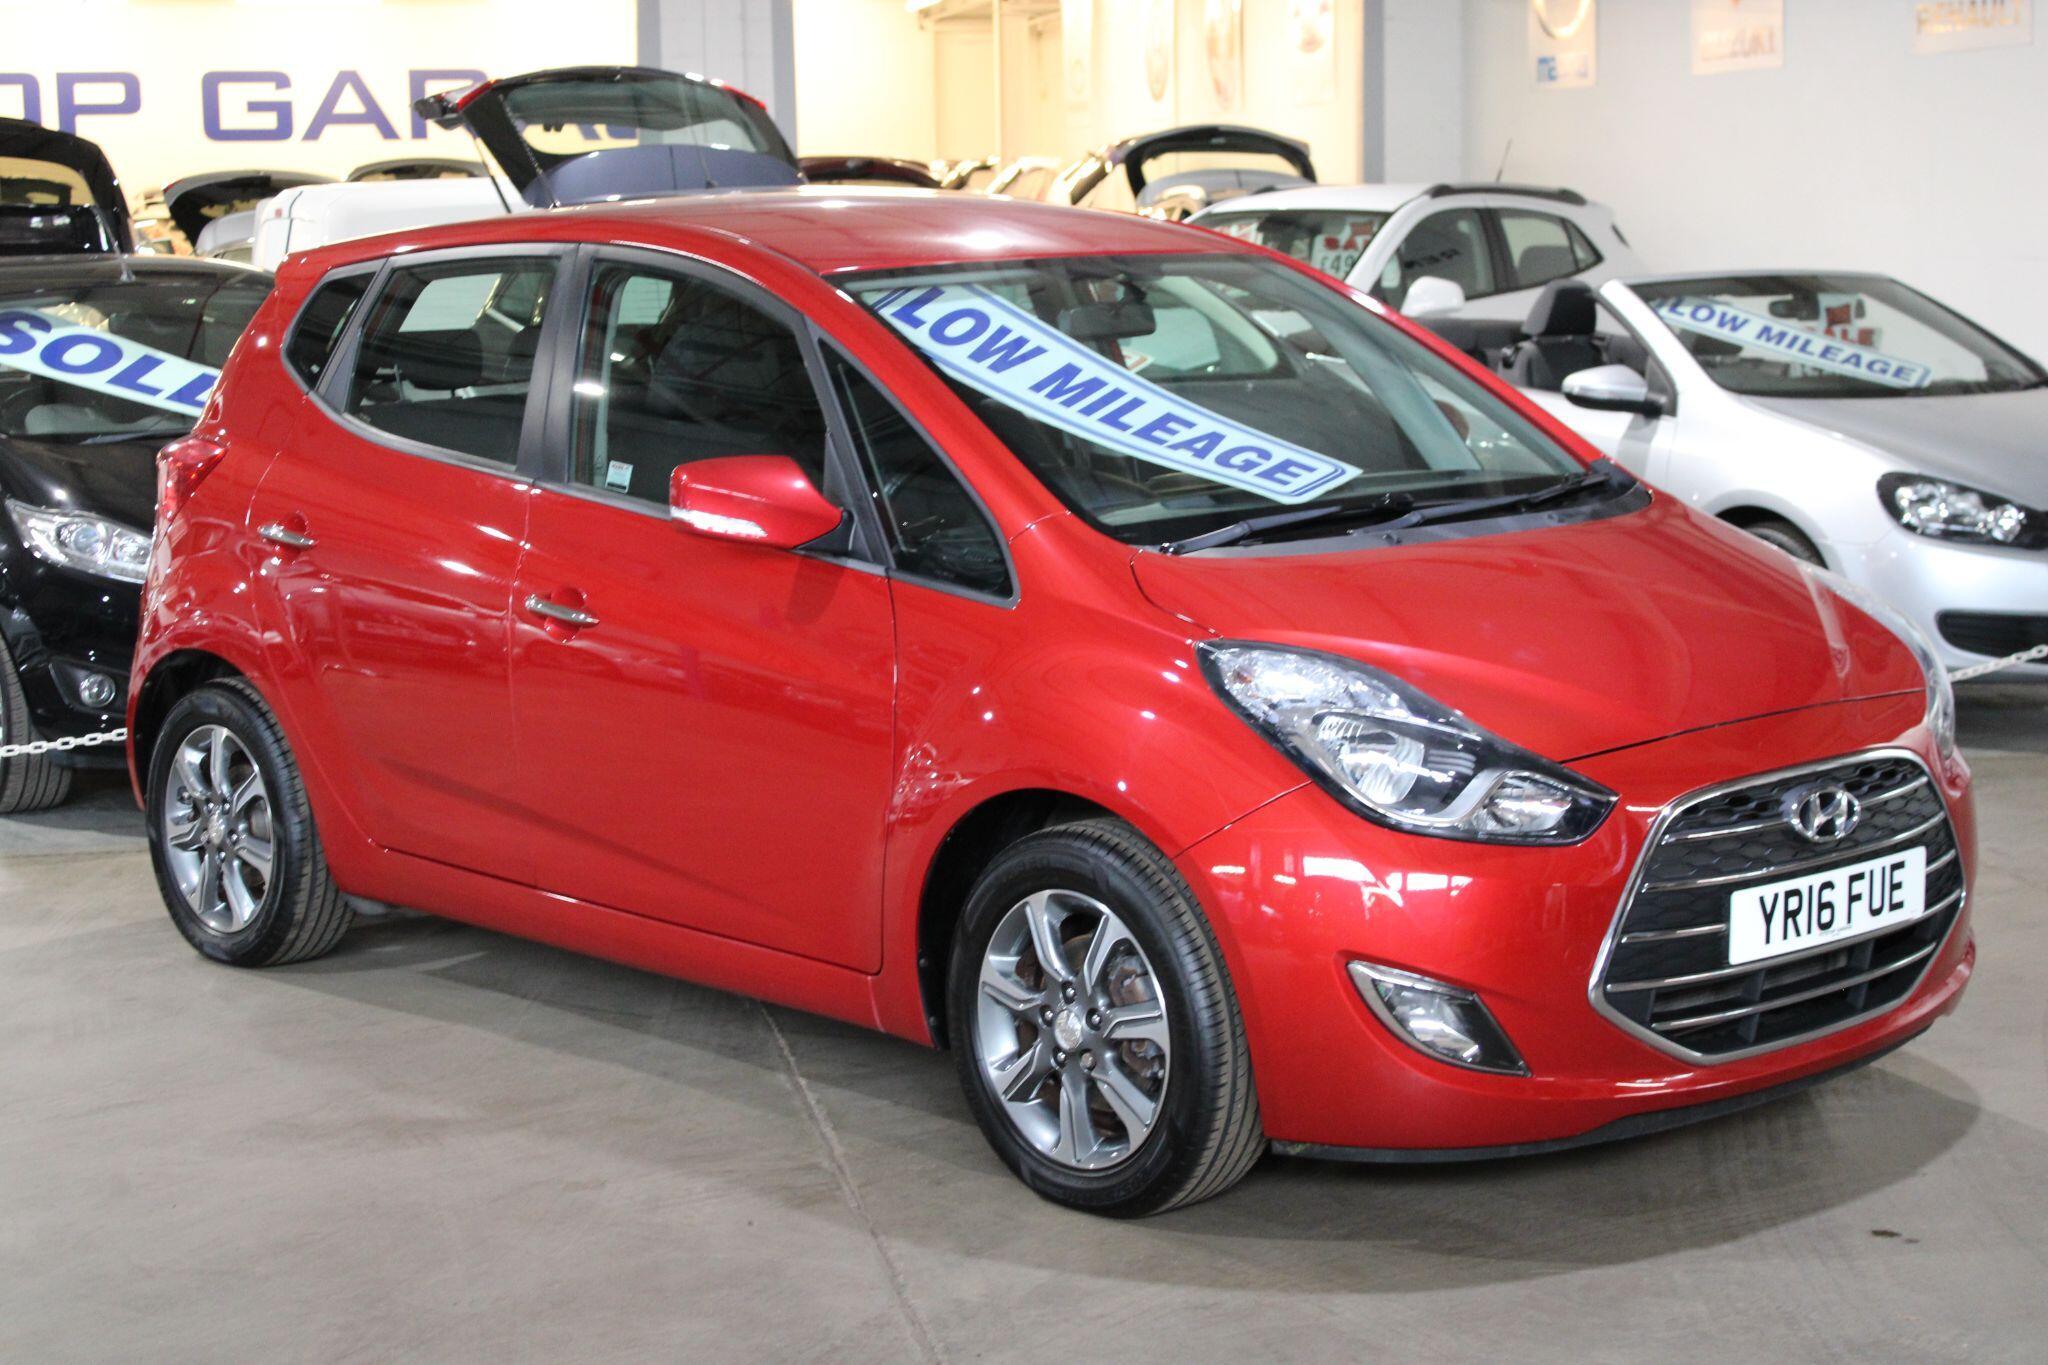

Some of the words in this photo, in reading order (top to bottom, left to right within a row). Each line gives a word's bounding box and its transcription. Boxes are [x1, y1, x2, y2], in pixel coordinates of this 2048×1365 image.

[1667, 295, 1750, 333] LOW
[1753, 324, 1918, 383] MILEAGE
[1805, 326, 1876, 347] ALE
[891, 285, 1047, 375] LOW
[1027, 361, 1318, 486] MILEAGE
[1759, 880, 1836, 945] YR16
[1847, 860, 1906, 925] FUE
